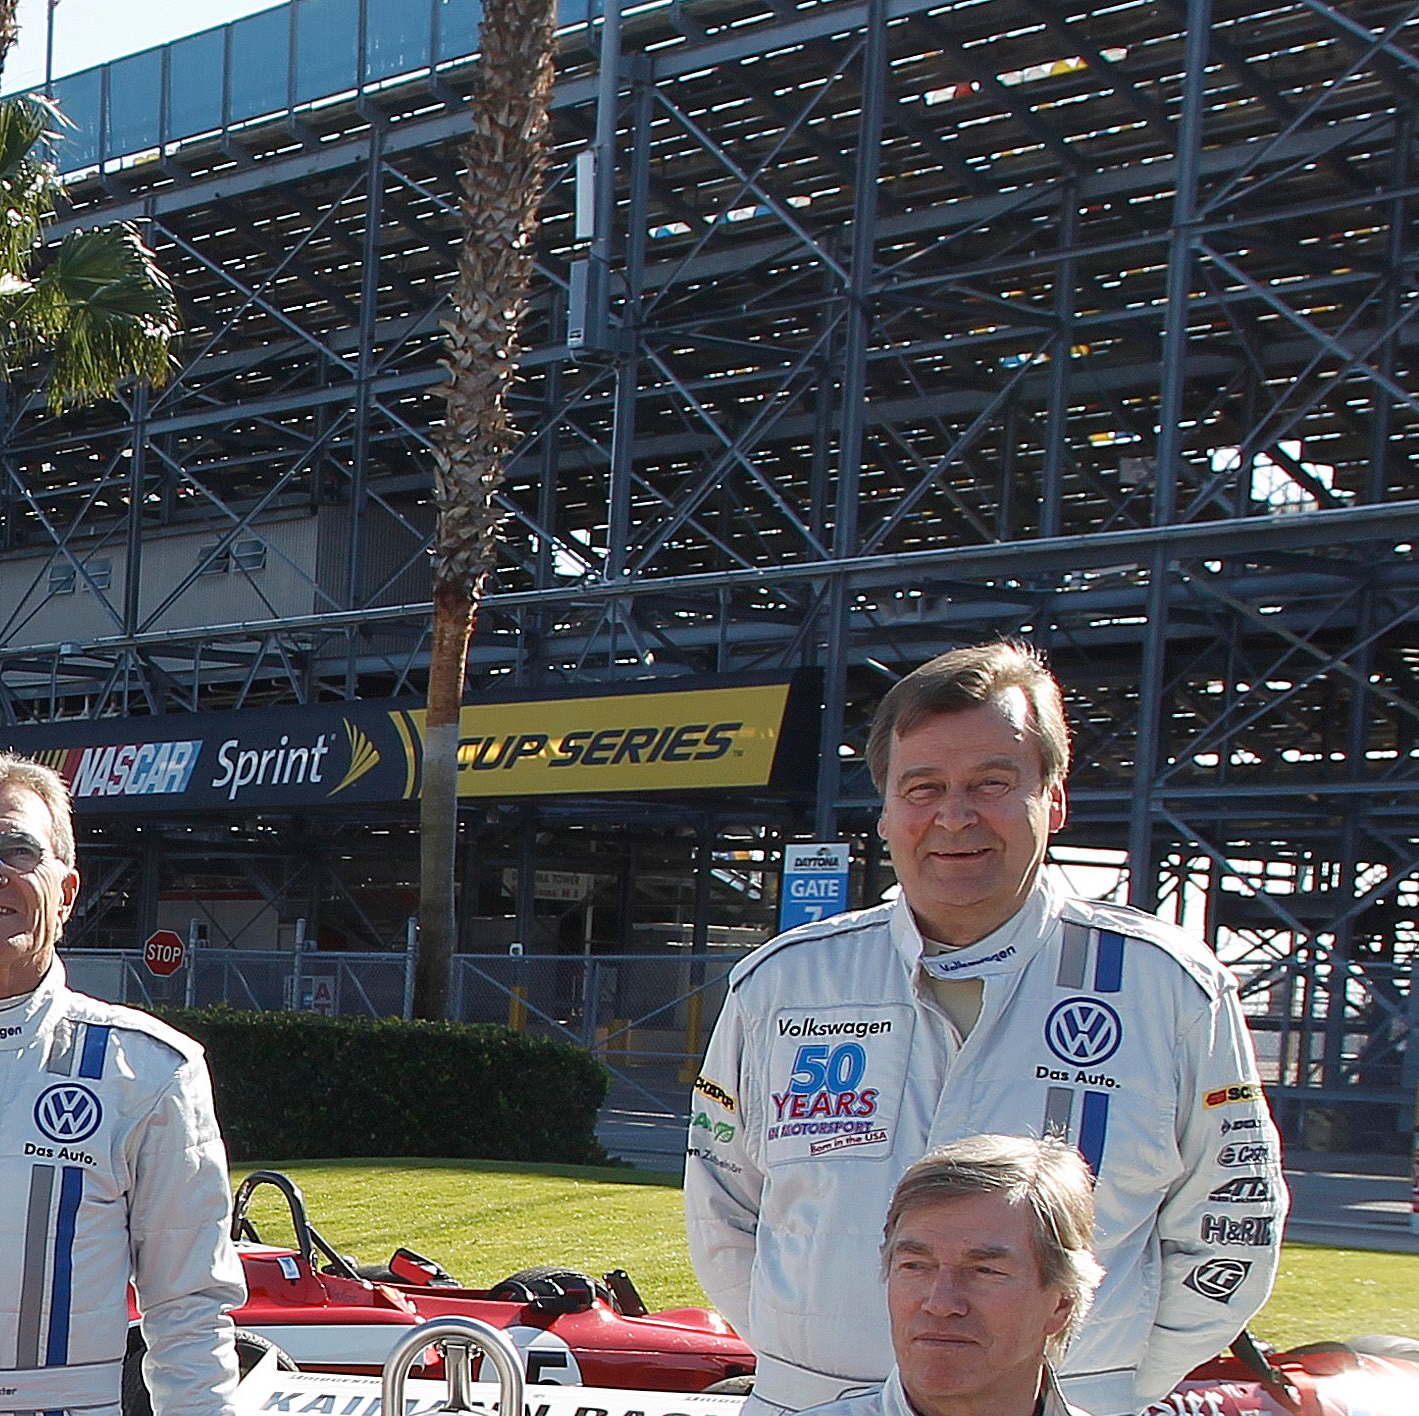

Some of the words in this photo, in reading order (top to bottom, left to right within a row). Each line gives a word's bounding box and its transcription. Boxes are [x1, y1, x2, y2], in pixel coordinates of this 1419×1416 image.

[71, 740, 193, 798] NASCAR
[213, 733, 329, 800] Sprint
[457, 734, 548, 771] CUP
[548, 722, 744, 767] SERIES
[790, 879, 840, 897] GATE
[804, 906, 824, 922] 7
[147, 943, 182, 963] STOP
[778, 1018, 892, 1038] Volkswagen
[790, 1042, 866, 1095] 50
[1036, 1066, 1067, 1083] Das
[1074, 1070, 1122, 1090] Auto.
[771, 1089, 880, 1121] YEARS
[781, 1121, 874, 1138] MOTORSPORT
[24, 1143, 55, 1158] Das
[58, 1147, 98, 1167] Auto.
[811, 1142, 832, 1155] Born
[833, 1139, 844, 1149] in
[845, 1135, 863, 1146] the
[865, 1131, 887, 1142] USA
